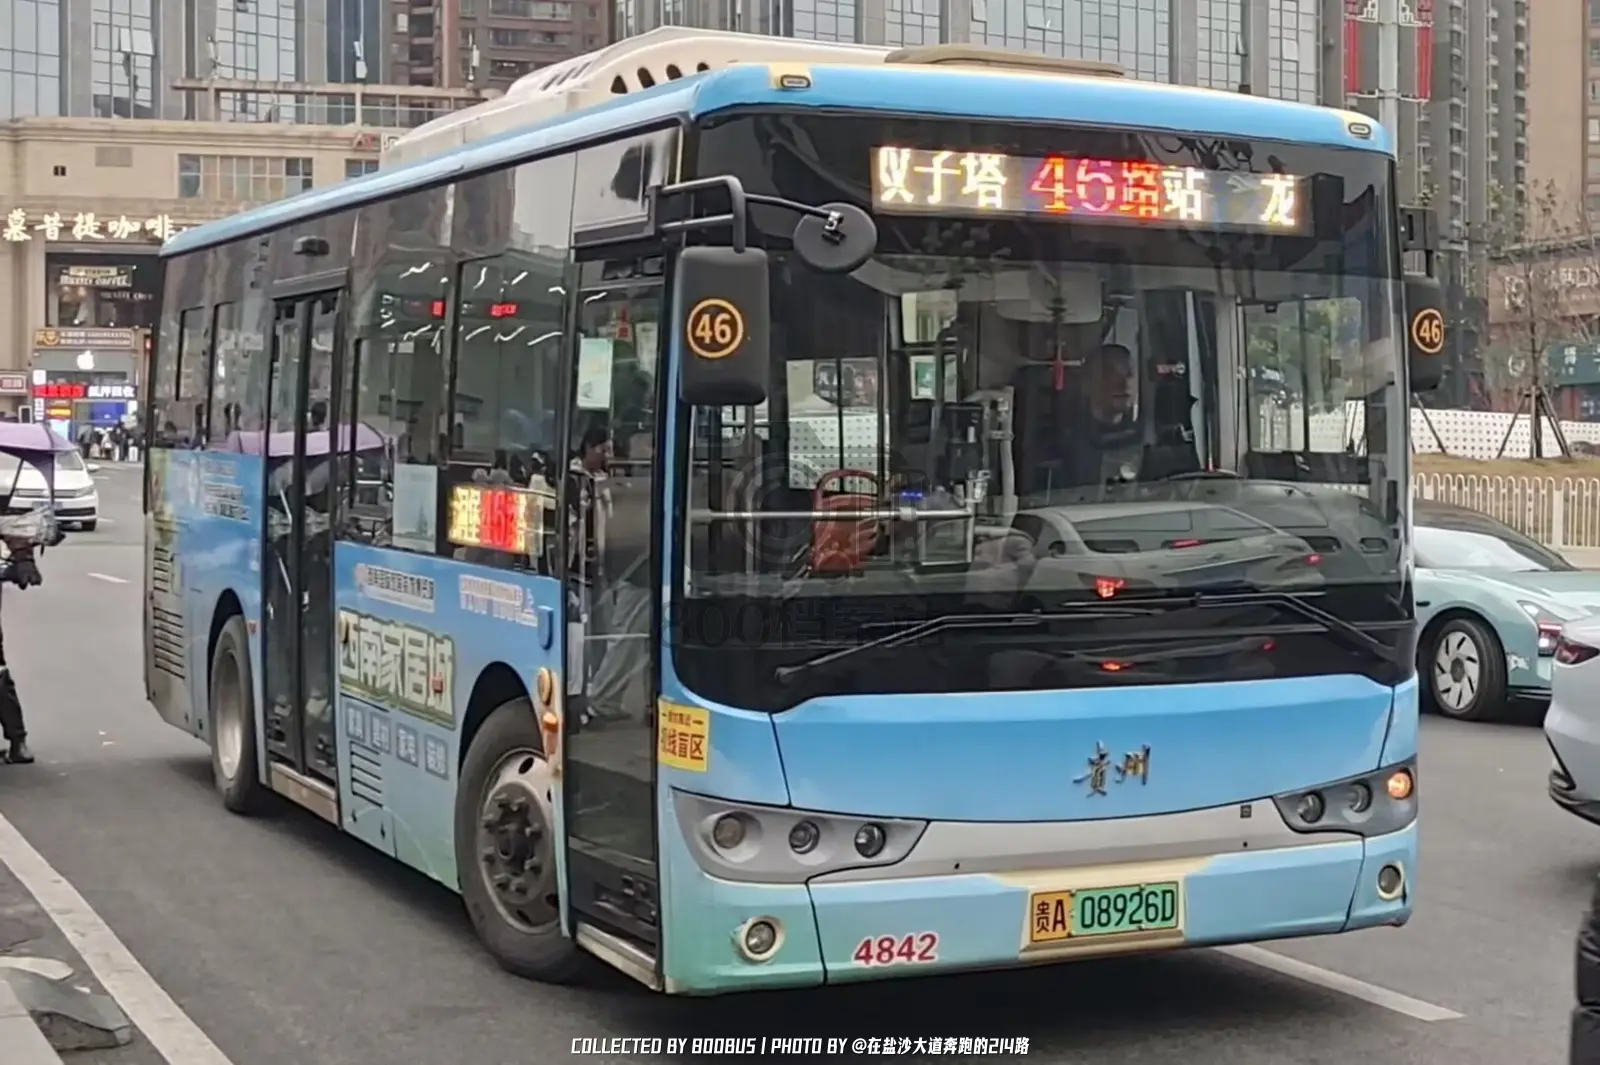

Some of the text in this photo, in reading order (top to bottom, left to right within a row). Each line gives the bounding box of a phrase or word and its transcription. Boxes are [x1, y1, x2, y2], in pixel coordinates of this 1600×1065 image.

[695, 313, 732, 345] 46
[1419, 319, 1441, 343] 46
[1035, 888, 1175, 933] 贵A 08926D
[854, 933, 938, 965] 4842
